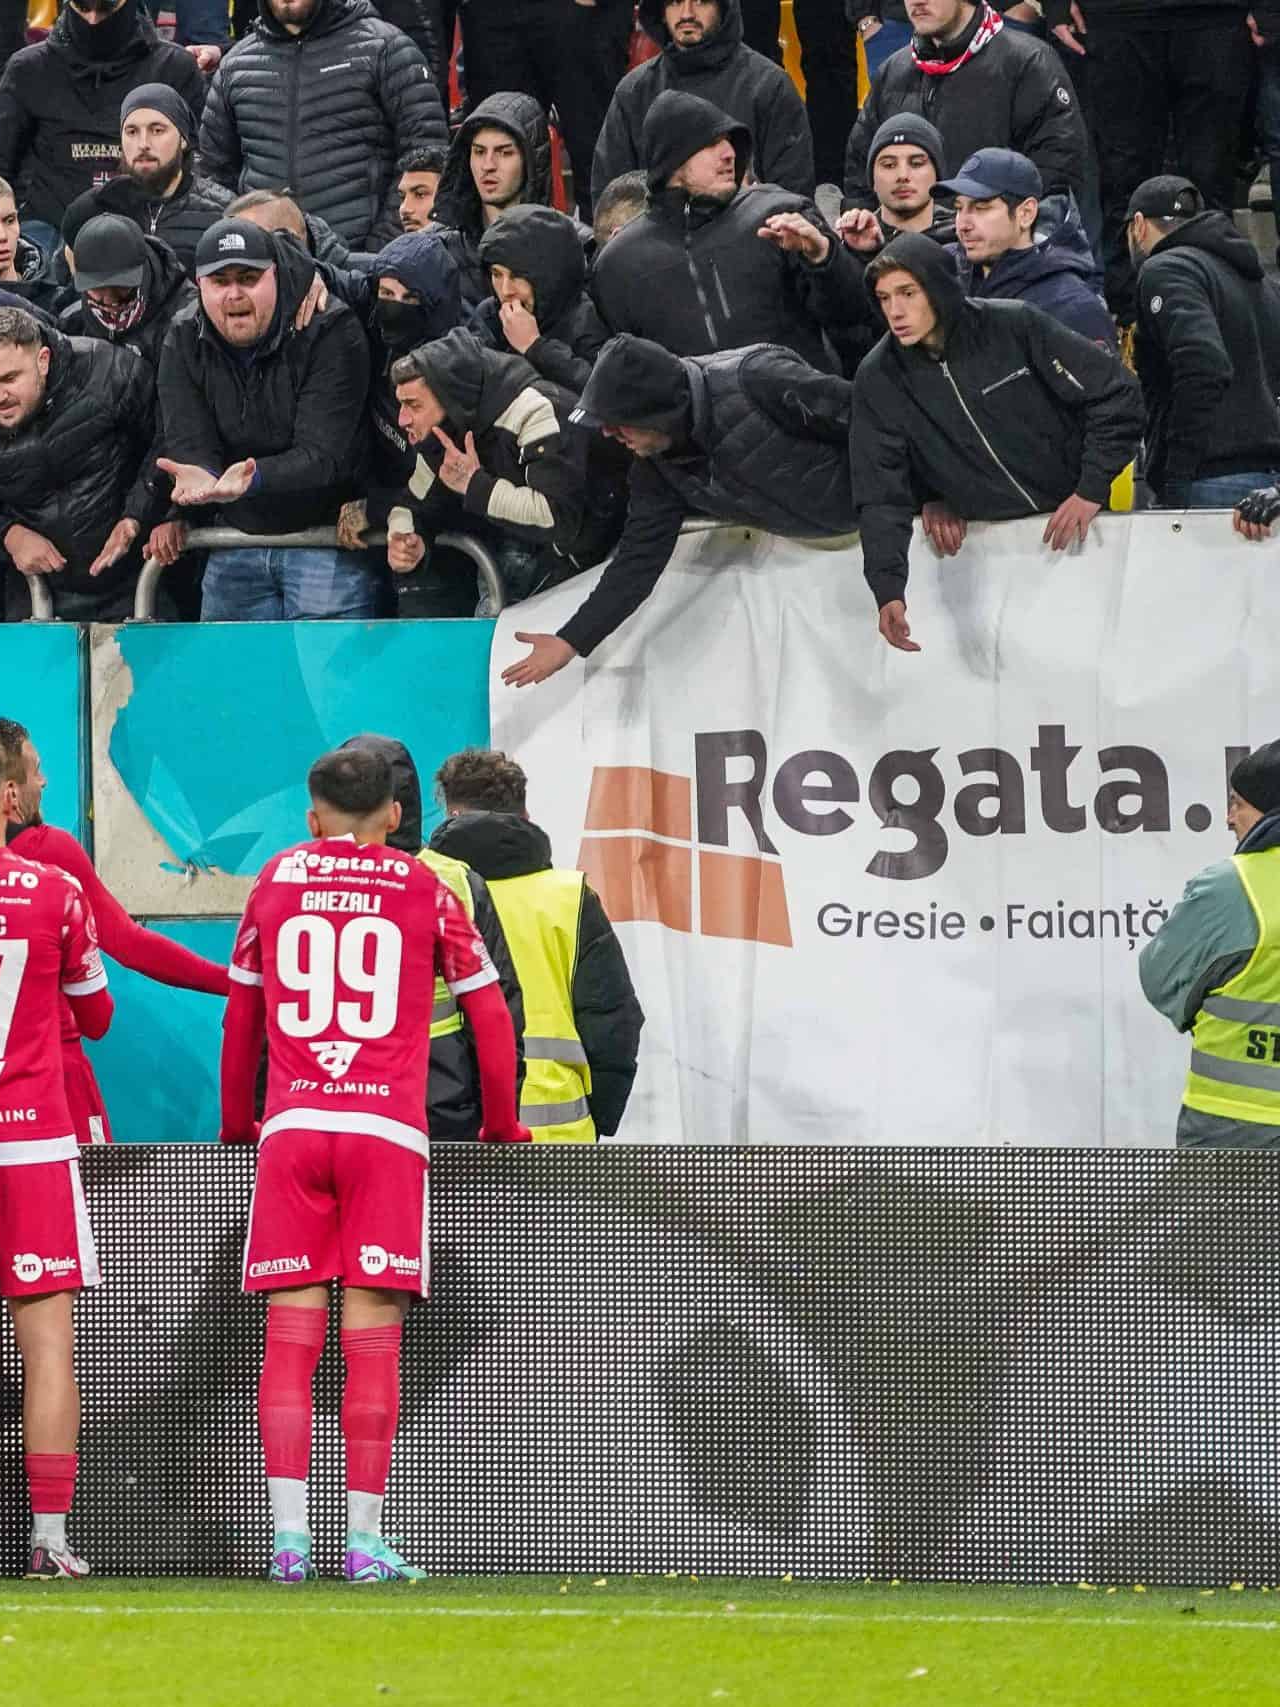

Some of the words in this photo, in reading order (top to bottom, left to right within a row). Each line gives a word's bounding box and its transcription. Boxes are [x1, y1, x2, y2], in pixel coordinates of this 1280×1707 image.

[293, 850, 410, 877] Regata.ro
[301, 890, 382, 914] GHEZALI
[817, 902, 966, 940] Gresie
[1006, 900, 1169, 950] Faianță
[276, 914, 403, 1039] 99
[322, 1082, 391, 1097] GAMING
[389, 1253, 421, 1271] Tehni
